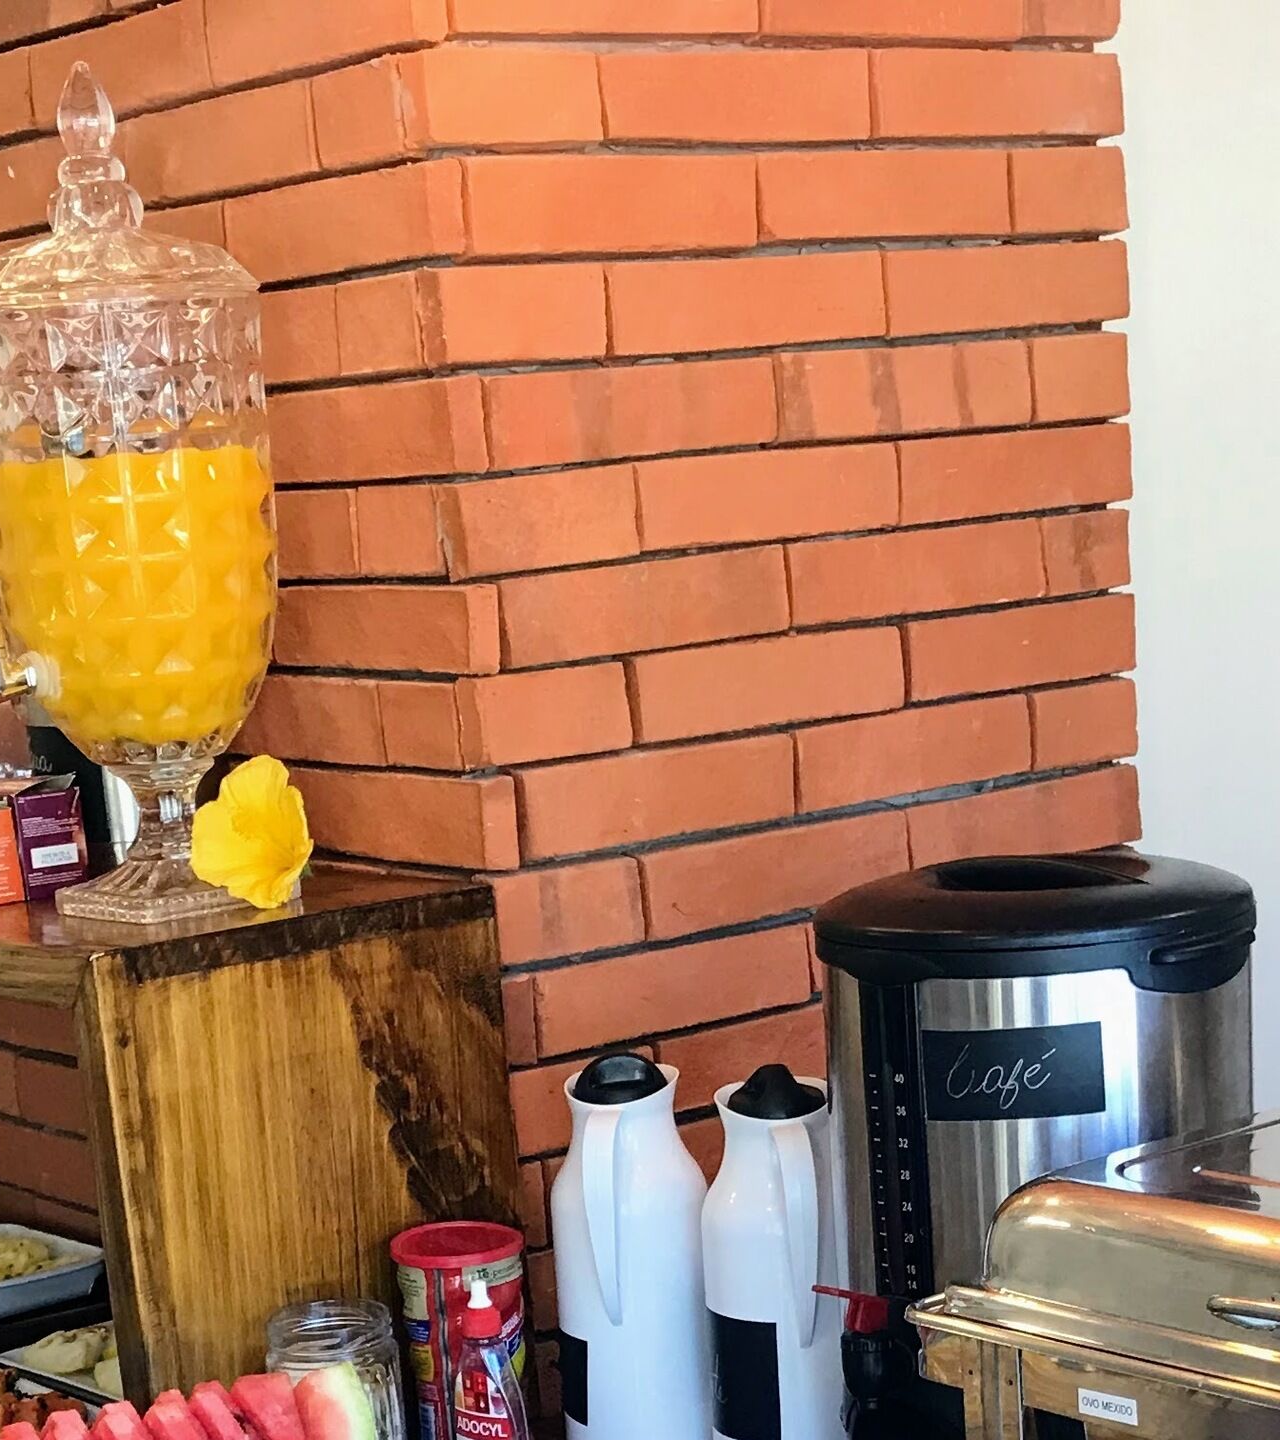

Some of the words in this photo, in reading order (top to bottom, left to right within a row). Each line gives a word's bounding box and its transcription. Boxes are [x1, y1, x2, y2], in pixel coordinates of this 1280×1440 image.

[894, 1073, 905, 1084] 40
[946, 1042, 1057, 1110] Café
[898, 1137, 909, 1149] 32
[900, 1170, 911, 1181] 28
[902, 1201, 913, 1212] 24
[904, 1233, 915, 1244] 20
[906, 1264, 916, 1275] 16
[907, 1280, 918, 1291] 14
[1081, 1396, 1100, 1409] OVO
[1101, 1400, 1134, 1416] MEXIDO
[457, 1416, 508, 1438] ADOCYL
